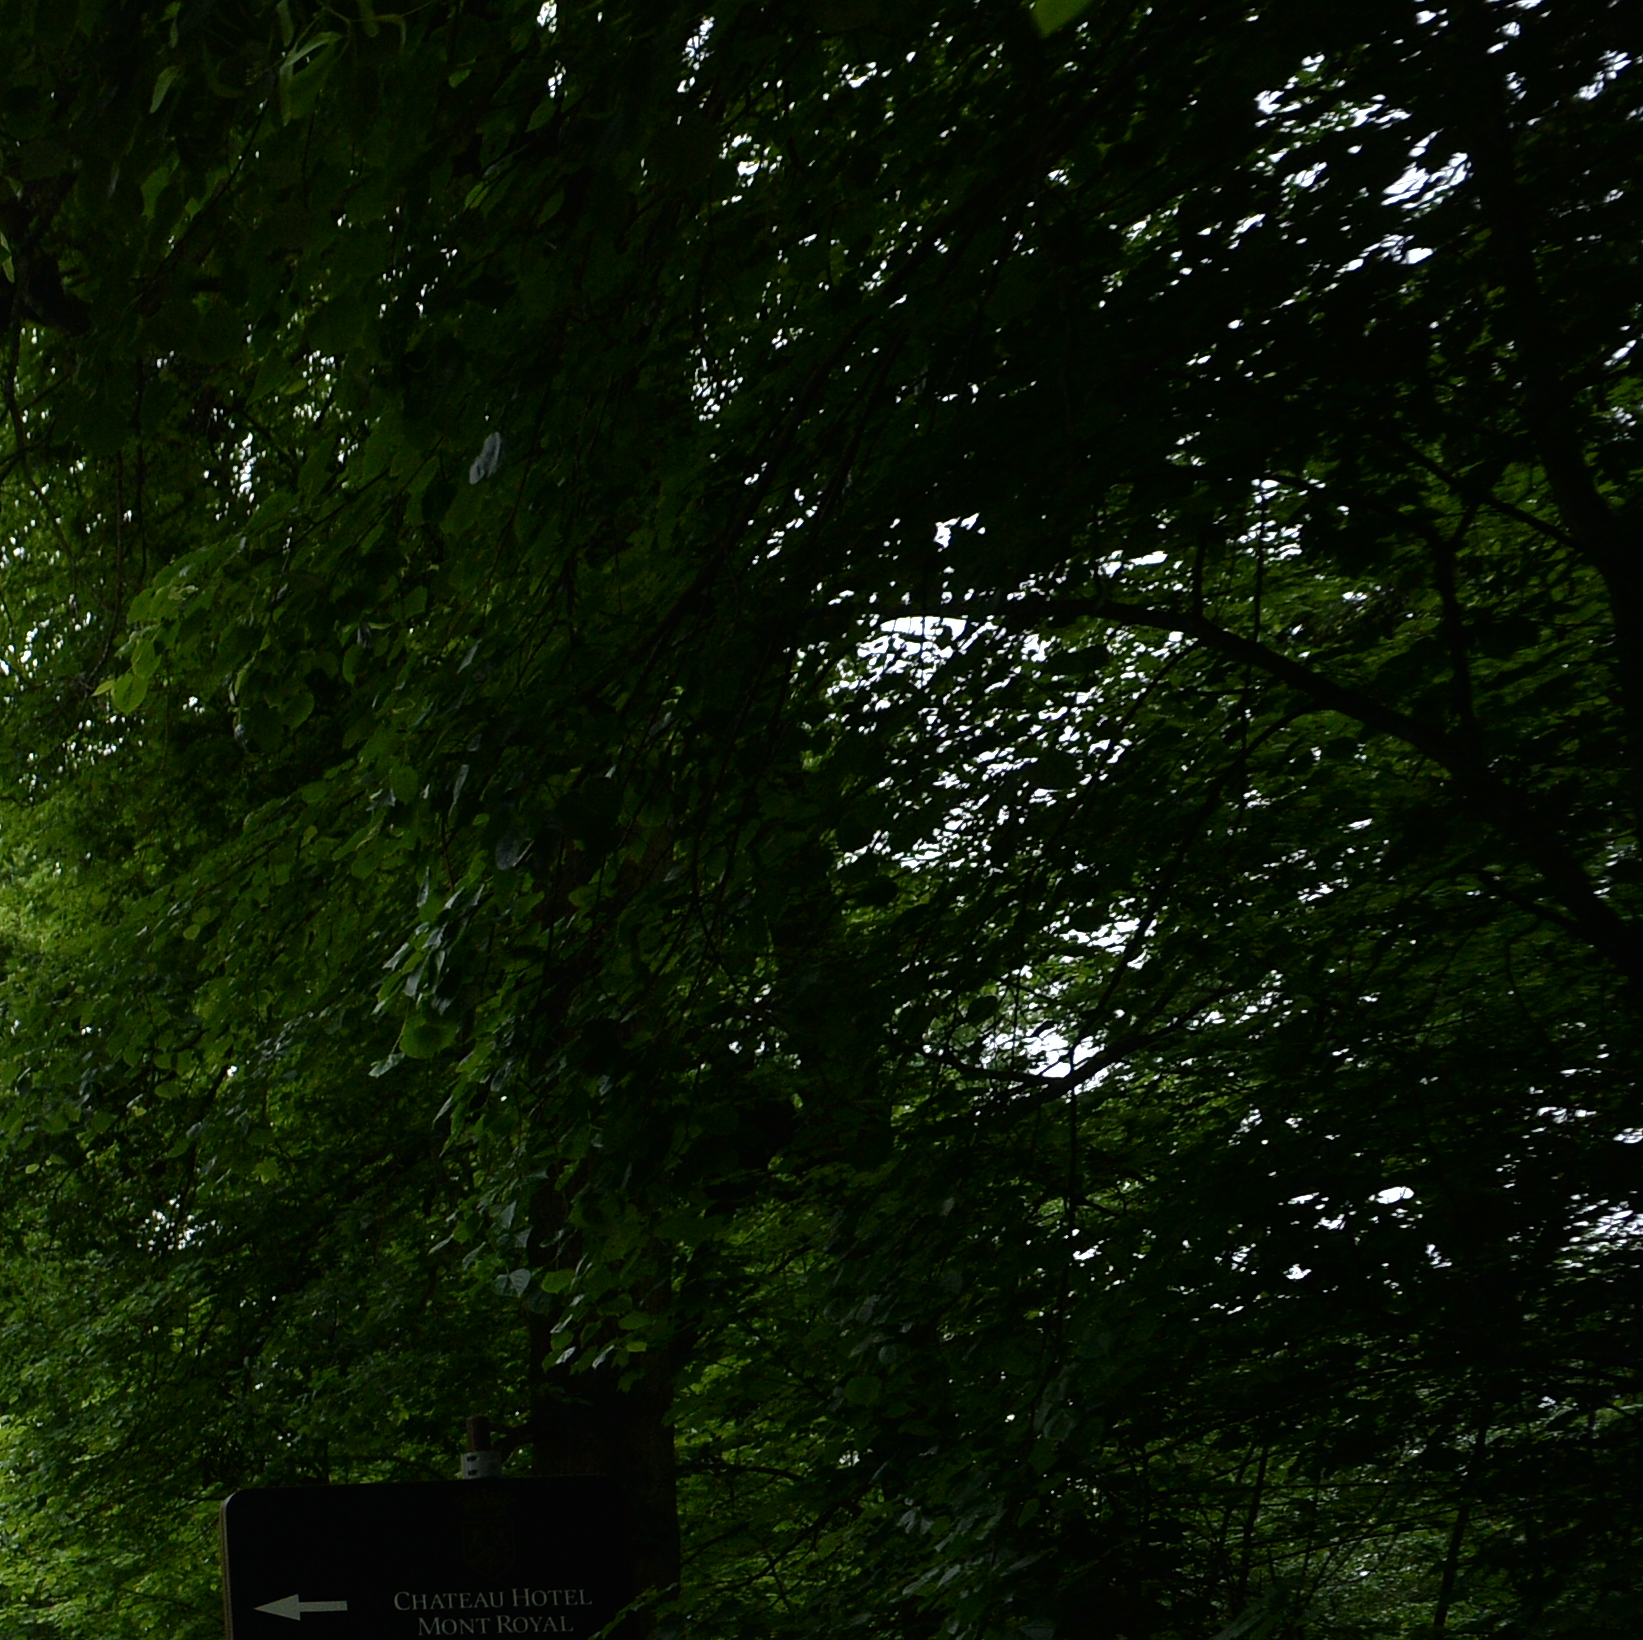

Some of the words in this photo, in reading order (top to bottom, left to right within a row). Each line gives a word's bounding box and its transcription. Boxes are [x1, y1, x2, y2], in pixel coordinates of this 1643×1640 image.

[393, 1589, 505, 1612] CHATEAU
[511, 1587, 593, 1609] HOTEL
[417, 1616, 491, 1637] MONT
[496, 1614, 574, 1634] ROYAL
